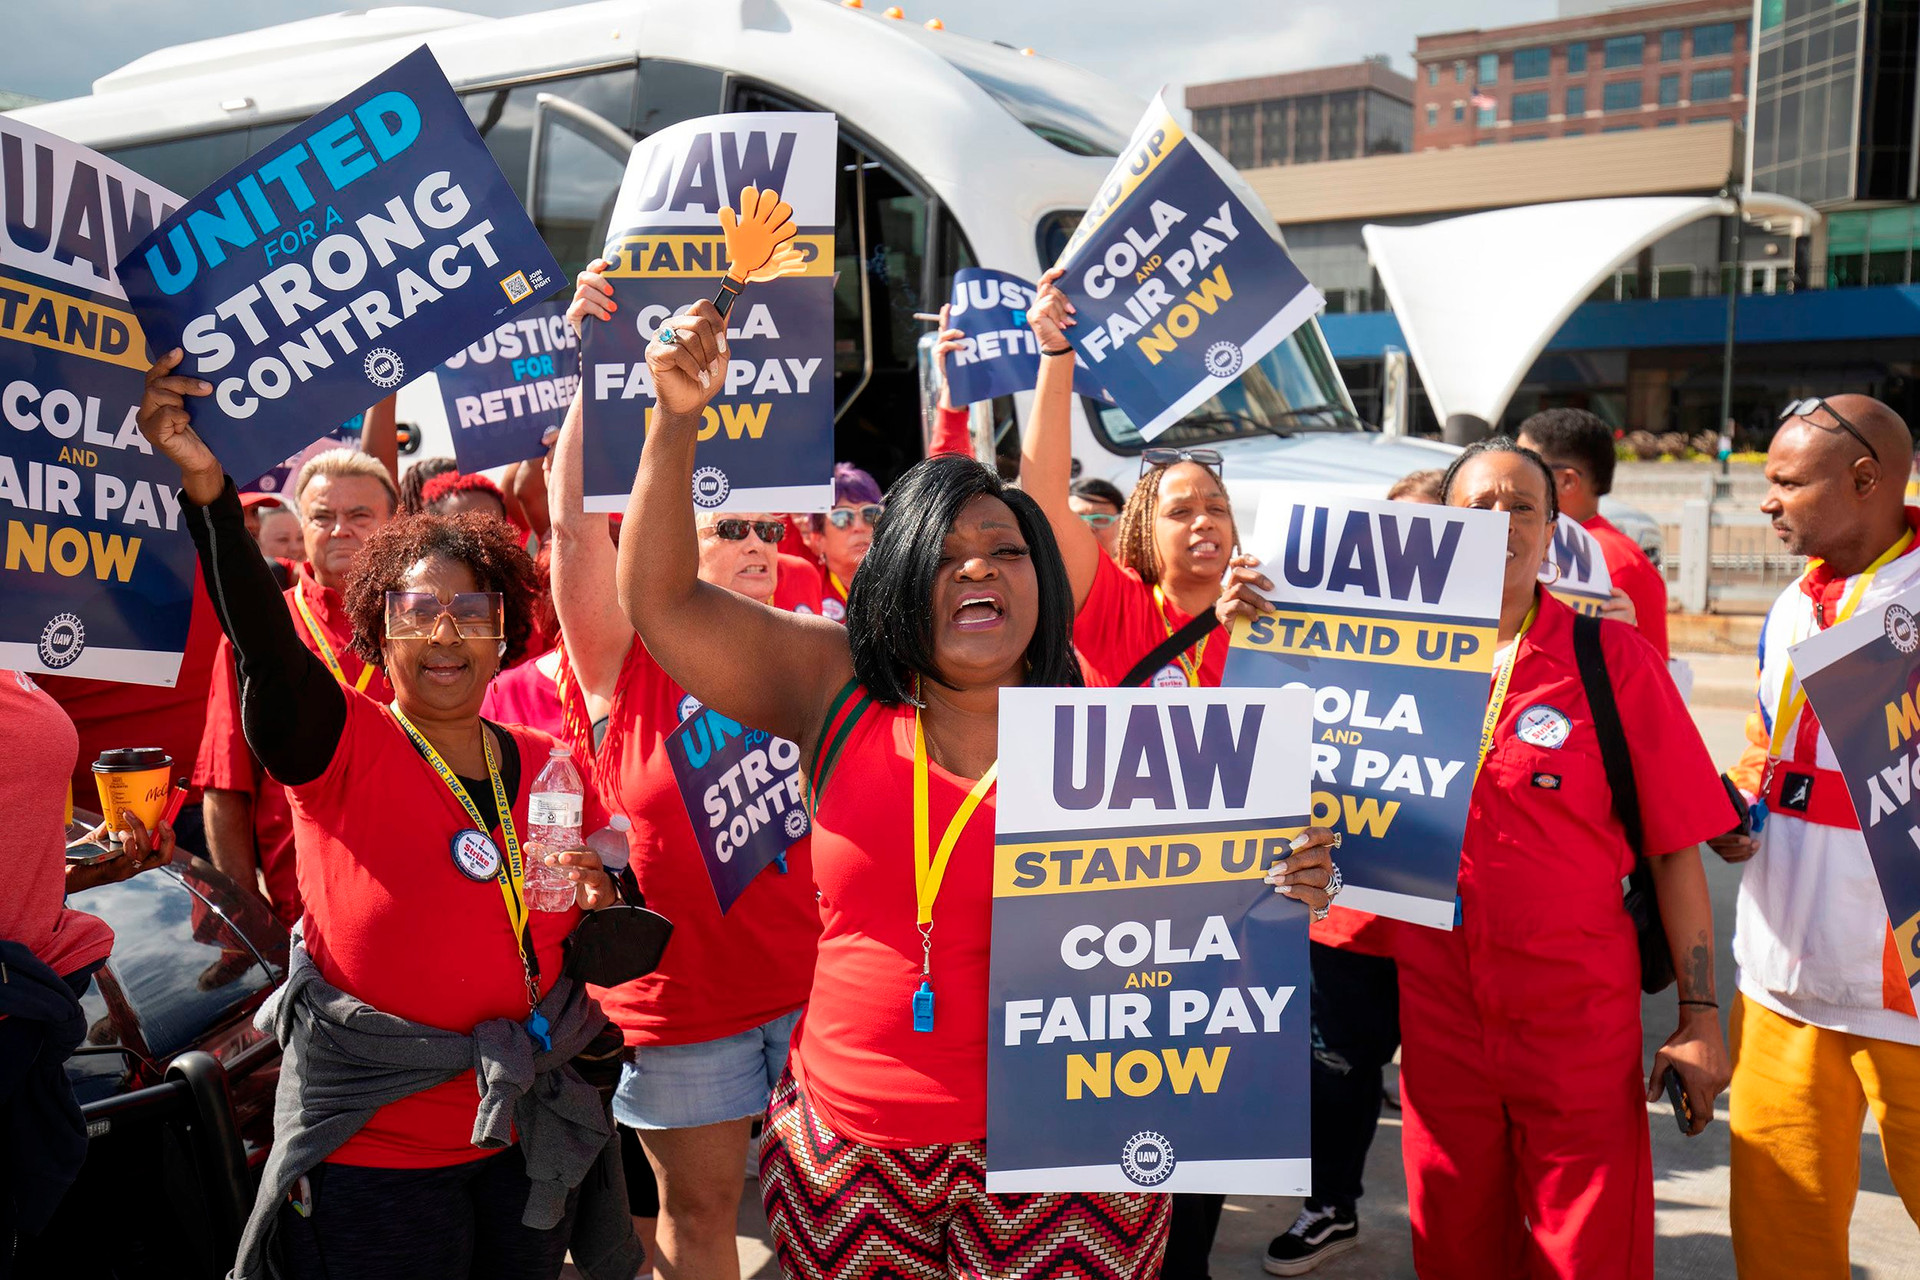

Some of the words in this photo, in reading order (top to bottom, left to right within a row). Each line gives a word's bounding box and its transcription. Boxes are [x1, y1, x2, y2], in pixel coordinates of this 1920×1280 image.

[639, 131, 797, 216] UAW
[1130, 129, 1165, 176] UP
[1, 132, 176, 281] UAW
[145, 91, 422, 295] UNITED
[264, 220, 318, 267] FOR
[325, 205, 344, 232] A
[604, 242, 733, 272] STAN
[1083, 200, 1187, 299] COLA
[182, 171, 471, 373] STRONG
[529, 268, 543, 281] JOIN
[531, 275, 544, 285] THE
[534, 276, 552, 290] FIGHT
[1081, 277, 1176, 364] FAIR
[1164, 200, 1240, 288] PAY
[1135, 254, 1162, 284] AND
[0, 289, 130, 355] TAND
[216, 218, 500, 419] CONTRACT
[636, 303, 780, 339] CA
[1136, 264, 1235, 366] NOW
[375, 360, 392, 375] UAW
[511, 355, 554, 381] FOR
[951, 329, 1042, 367] RETI
[594, 363, 658, 400] FA
[724, 358, 822, 396] PAY
[2, 380, 154, 455] COLA
[645, 403, 772, 444] OW
[58, 446, 98, 468] AND
[0, 455, 81, 517] AIR
[95, 473, 185, 531] PAY
[700, 481, 718, 490] UAW
[5, 520, 142, 582] NOW
[1283, 504, 1465, 605] UAW
[53, 633, 73, 646] UAW
[1246, 615, 1400, 657] STAND
[1416, 629, 1480, 663] UP
[1280, 682, 1423, 735] OLA
[1485, 712, 1495, 731] FOR
[744, 729, 769, 751] FO
[1052, 704, 1265, 810] UAW
[1321, 728, 1363, 745] AND
[399, 716, 433, 757] FIGHTING
[430, 756, 446, 777] FOR
[445, 774, 462, 793] THE
[459, 793, 489, 834] AMERIC
[492, 771, 507, 807] STRONG
[703, 736, 800, 828] STRO
[1350, 748, 1466, 798] PAY
[502, 809, 509, 817] A
[505, 817, 515, 837] FOR
[715, 771, 800, 863] CONTR
[1311, 791, 1401, 839] OW
[464, 843, 490, 867] Strike
[508, 837, 522, 878] UNITED
[1012, 843, 1201, 888] STAND
[1220, 837, 1293, 874] UP
[1060, 915, 1240, 970] COLA
[1124, 971, 1173, 989] AND
[1004, 993, 1152, 1047] FAIR
[1169, 985, 1297, 1037] PAY
[1066, 1046, 1231, 1100] NOW
[1137, 1151, 1158, 1162] UAW
